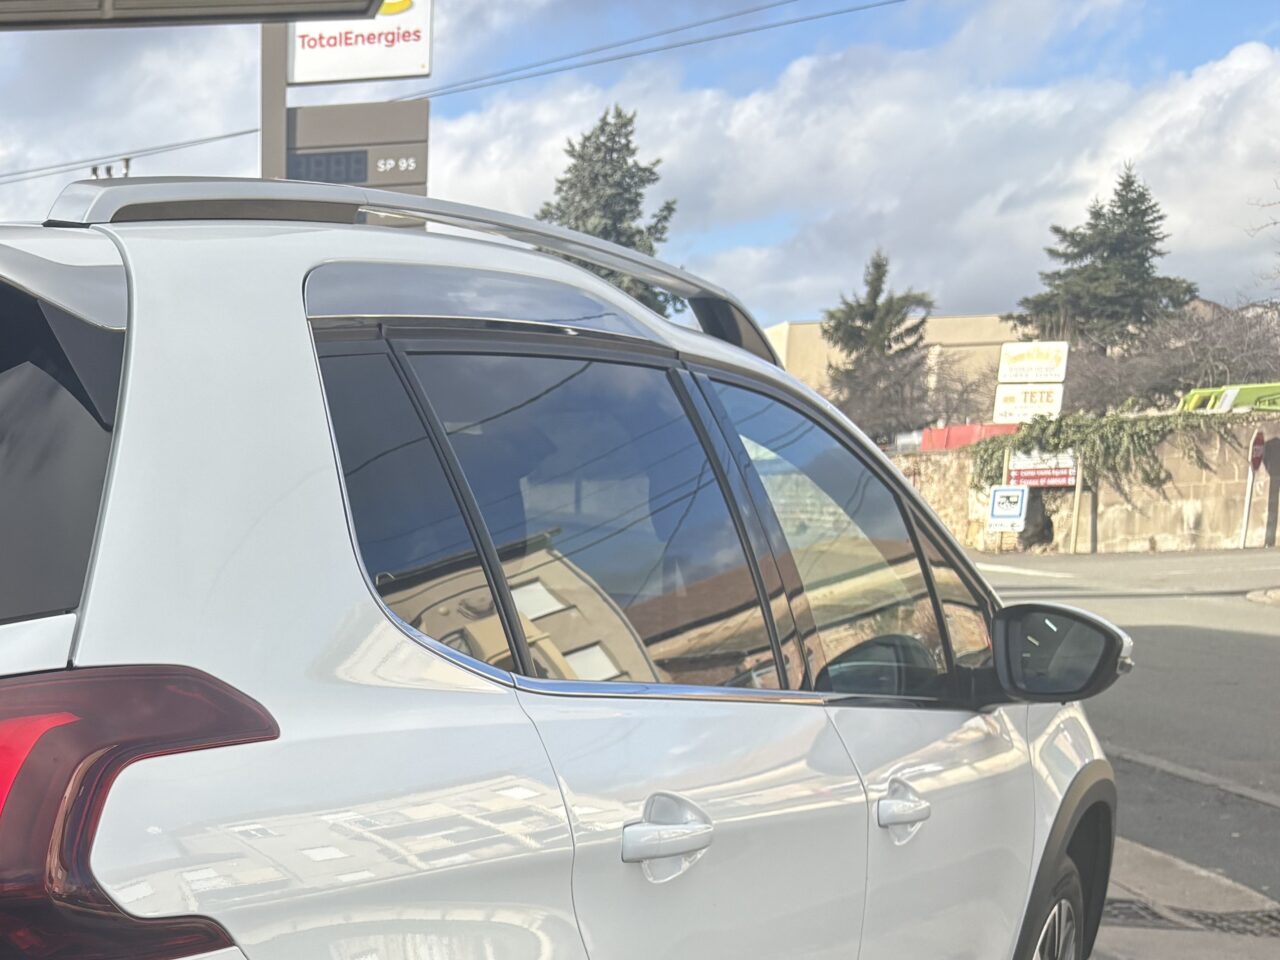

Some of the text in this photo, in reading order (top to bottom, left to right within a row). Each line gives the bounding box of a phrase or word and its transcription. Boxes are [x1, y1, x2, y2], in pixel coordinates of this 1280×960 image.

[298, 27, 422, 49] TotalEnergies
[377, 157, 417, 172] SP 95
